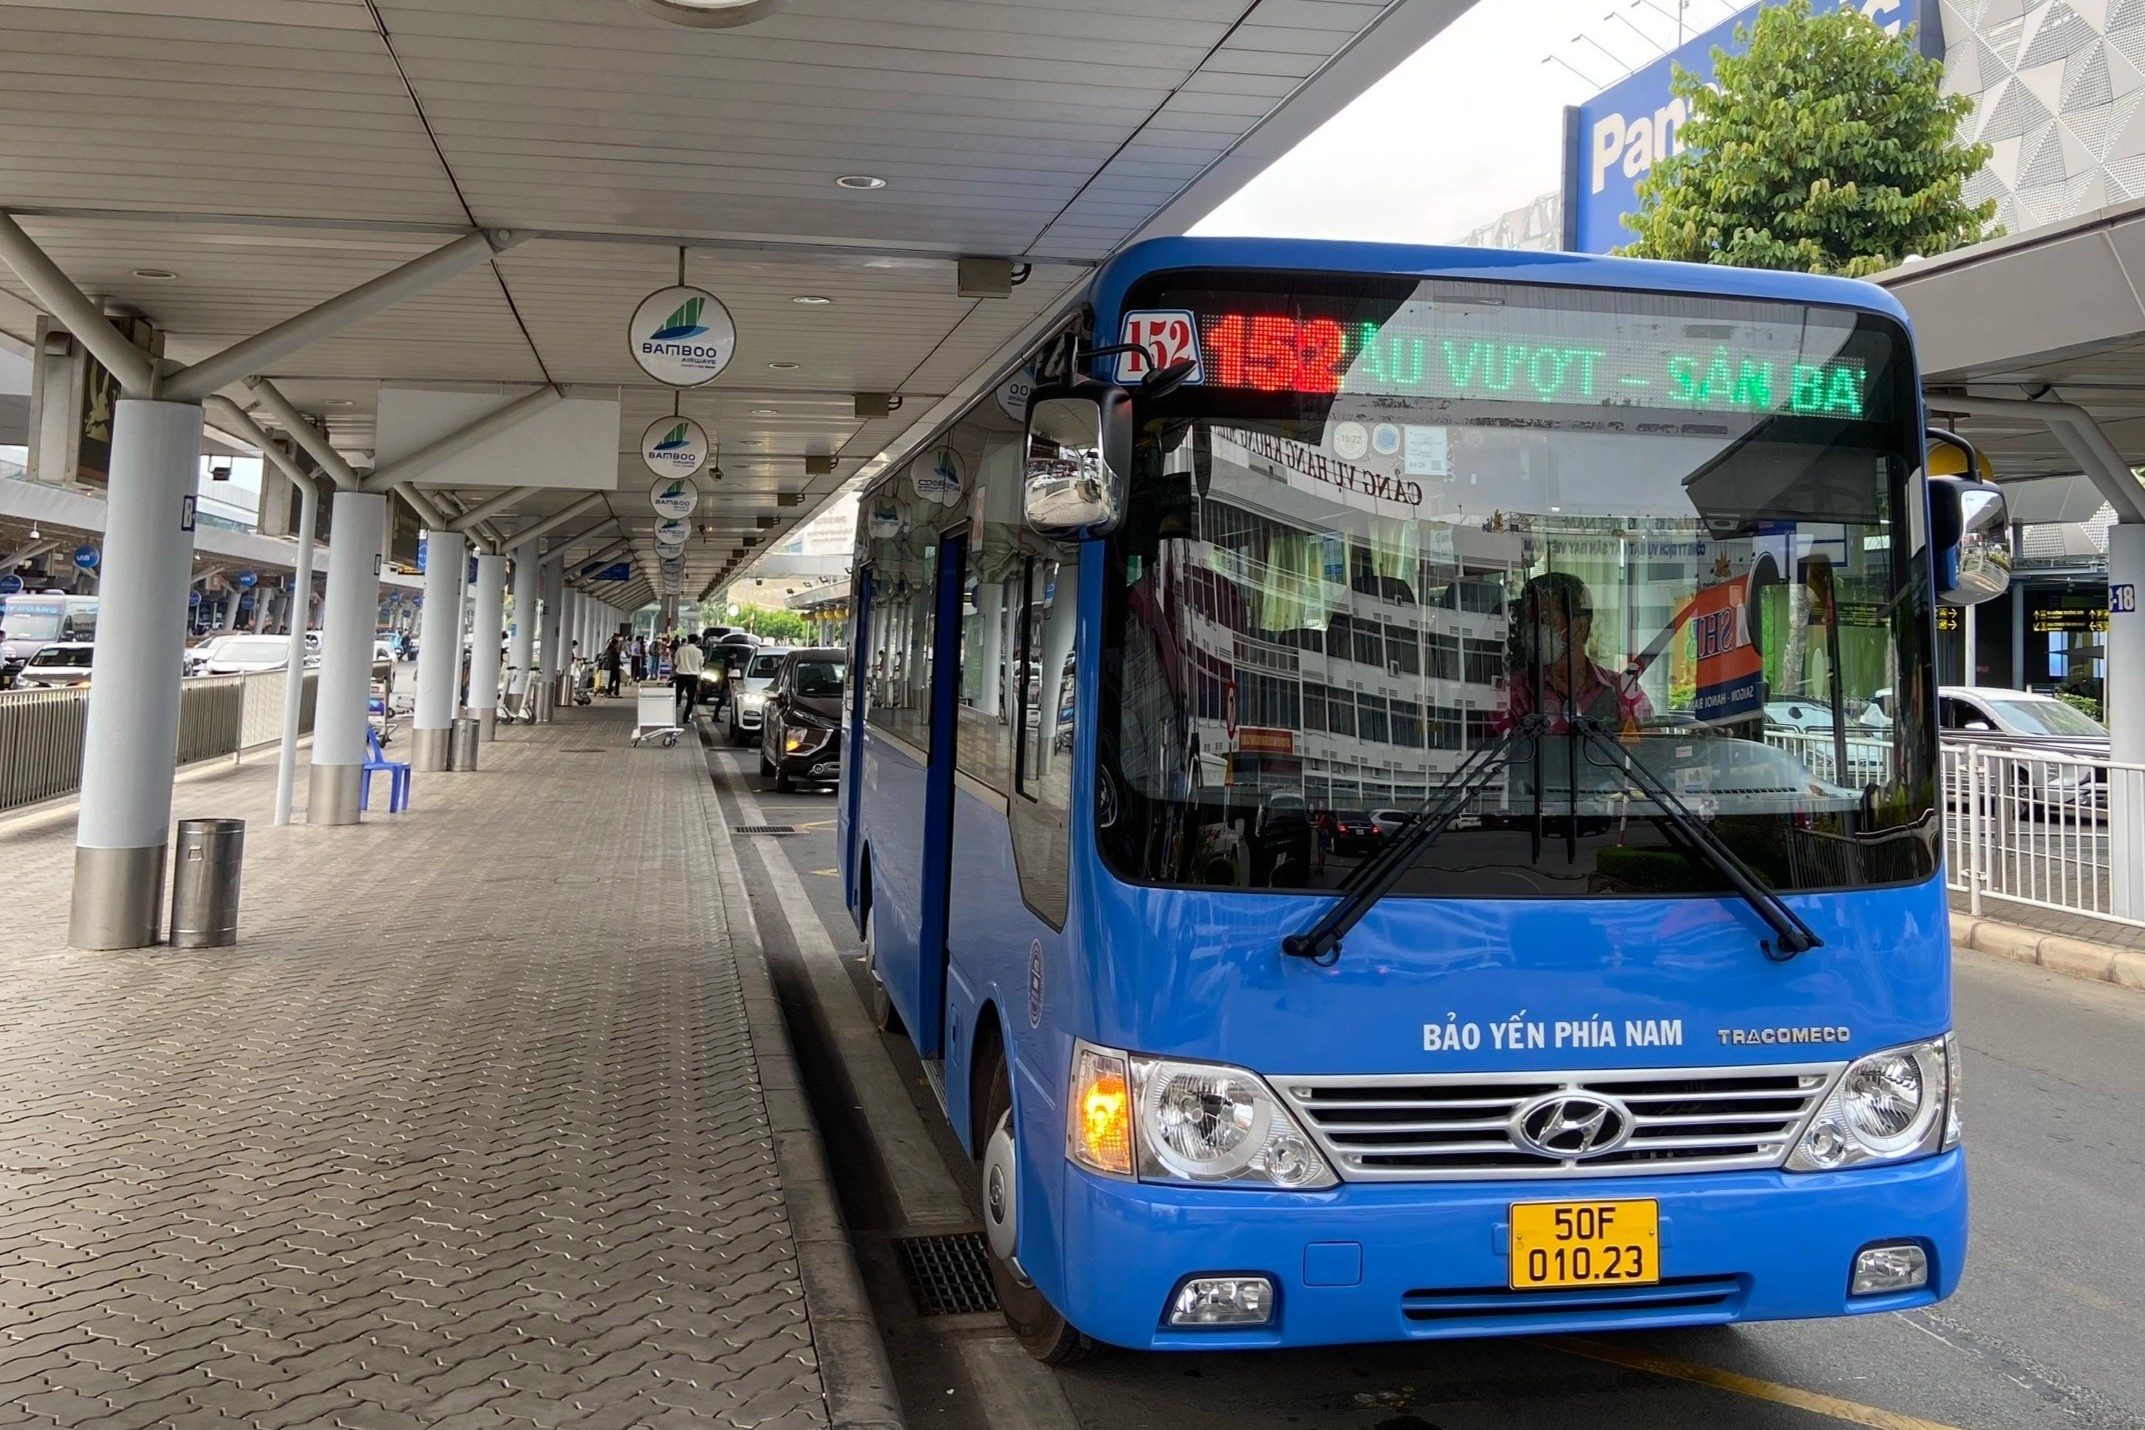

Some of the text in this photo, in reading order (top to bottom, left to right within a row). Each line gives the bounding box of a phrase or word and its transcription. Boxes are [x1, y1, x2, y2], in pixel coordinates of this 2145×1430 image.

[642, 342, 717, 358] BAMBOO
[1127, 319, 1190, 373] 152
[681, 357, 716, 365] AIRWAYS
[1208, 314, 1344, 393] 152
[1443, 340, 1607, 402] VƯỢT
[1667, 345, 1772, 408] SÂN
[1792, 363, 1867, 414] BA
[648, 451, 696, 461] BAMBOO
[655, 499, 690, 507] BAMBOO
[2109, 586, 2135, 611] -18
[1423, 1009, 1683, 1051] BẢO YẾN PHÍA NAM
[1717, 1026, 1850, 1046] TRACOMECO
[1555, 1207, 1616, 1240] 50F
[1529, 1245, 1643, 1281] 010.23
